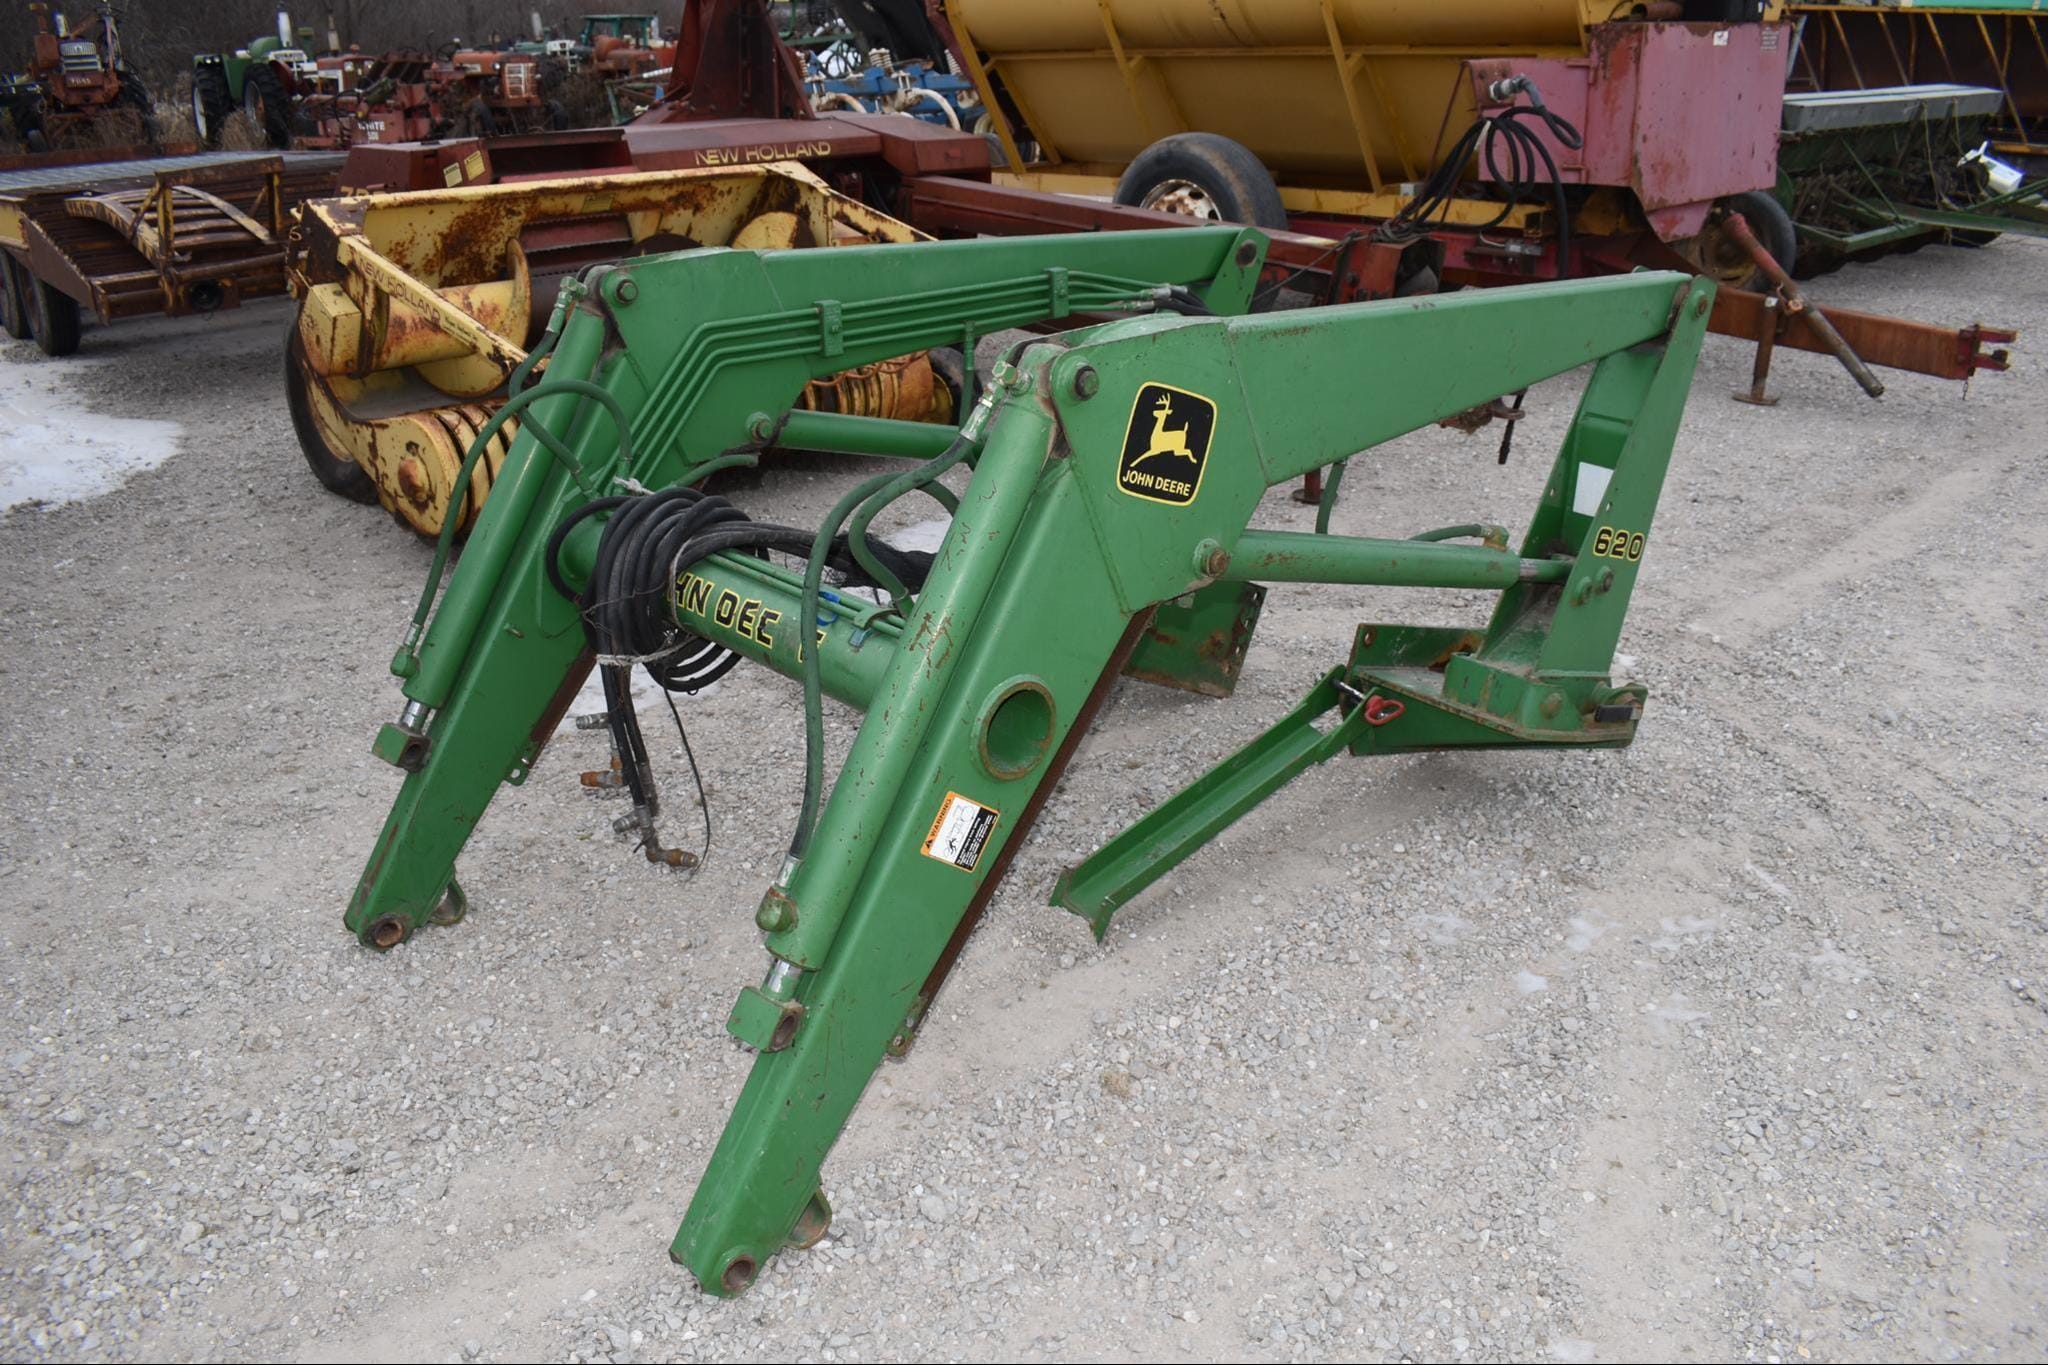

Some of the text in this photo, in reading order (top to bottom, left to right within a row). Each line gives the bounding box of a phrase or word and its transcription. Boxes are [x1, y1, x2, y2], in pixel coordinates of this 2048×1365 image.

[694, 141, 831, 166] NEW HOLLAND
[359, 258, 441, 322] NEW HOLLAND
[1122, 469, 1192, 497] JOHN DEERE
[1592, 525, 1646, 562] 620
[930, 798, 952, 837] WARNING
